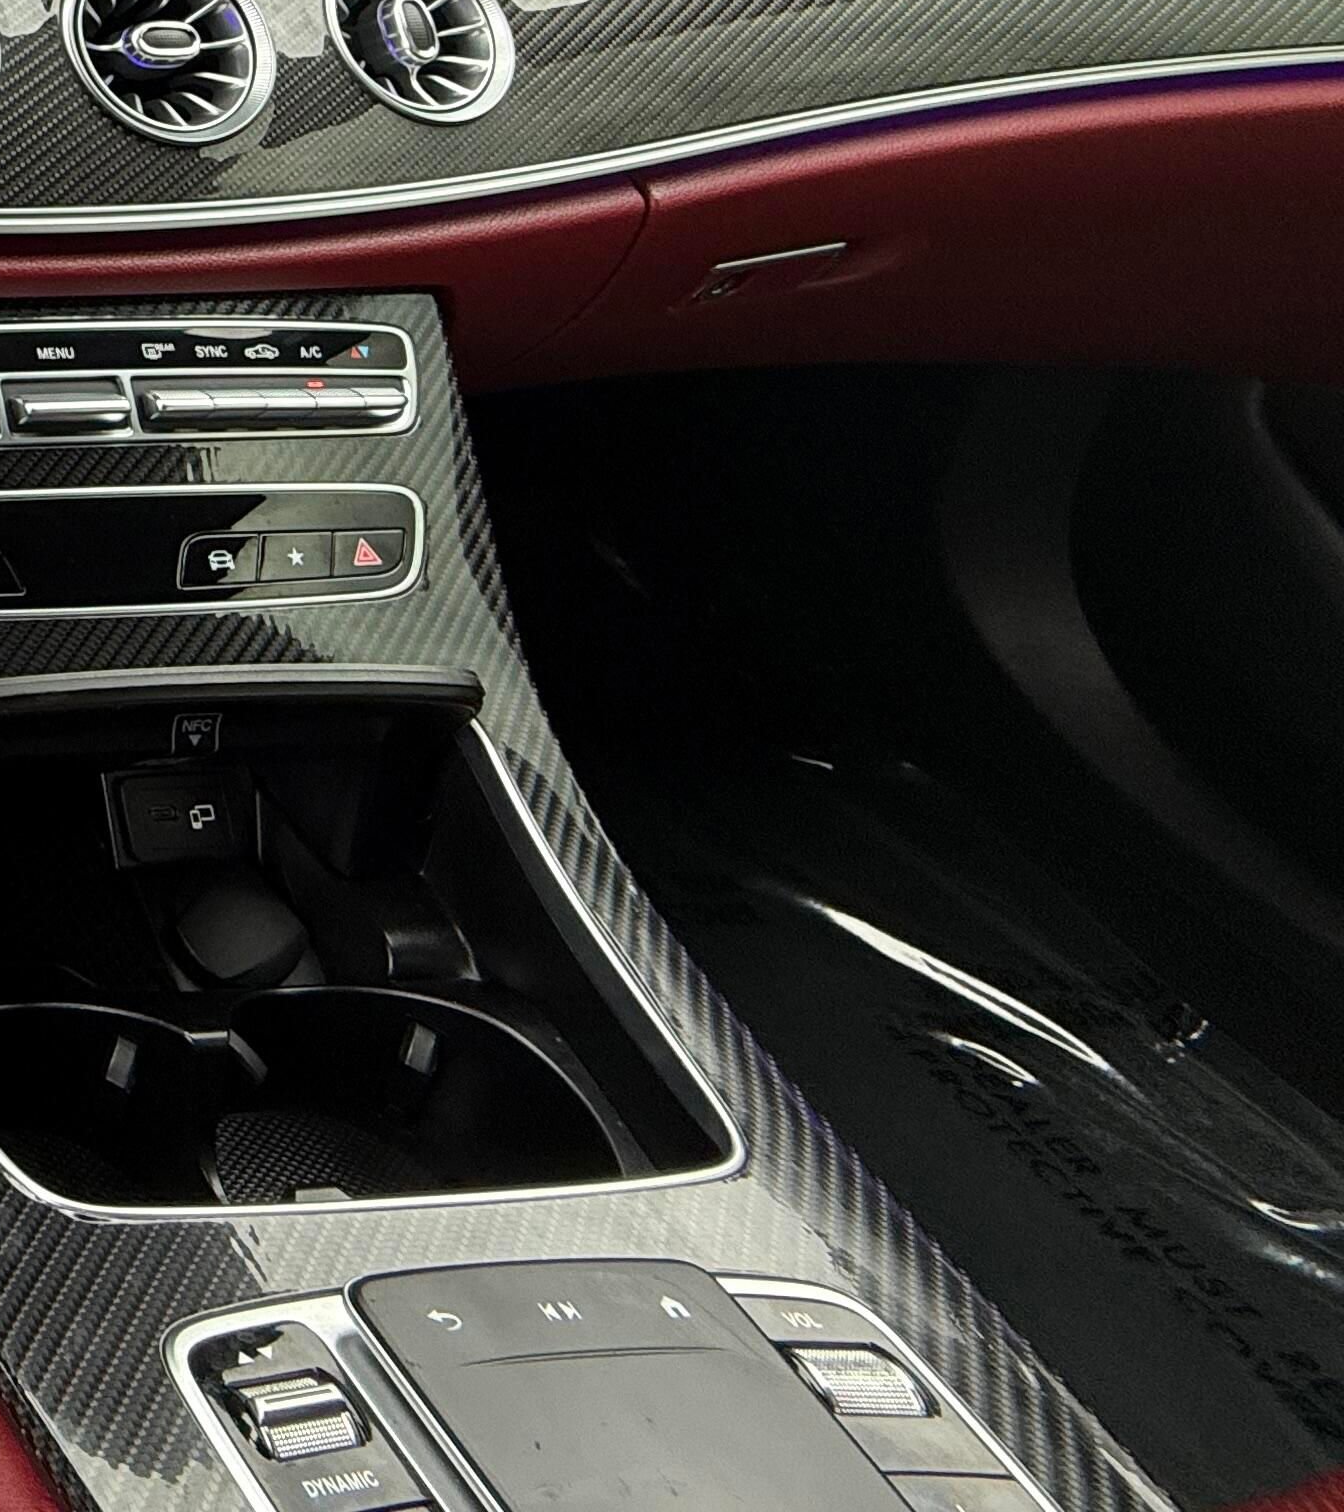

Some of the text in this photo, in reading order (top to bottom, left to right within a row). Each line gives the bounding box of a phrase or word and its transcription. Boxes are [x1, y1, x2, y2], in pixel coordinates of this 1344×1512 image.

[36, 347, 75, 360] MENU
[195, 344, 228, 359] SYNC
[300, 345, 322, 359] A/C
[182, 719, 212, 732] NFC
[781, 1310, 824, 1330] VOL
[301, 1470, 380, 1499] DYNAMIC
